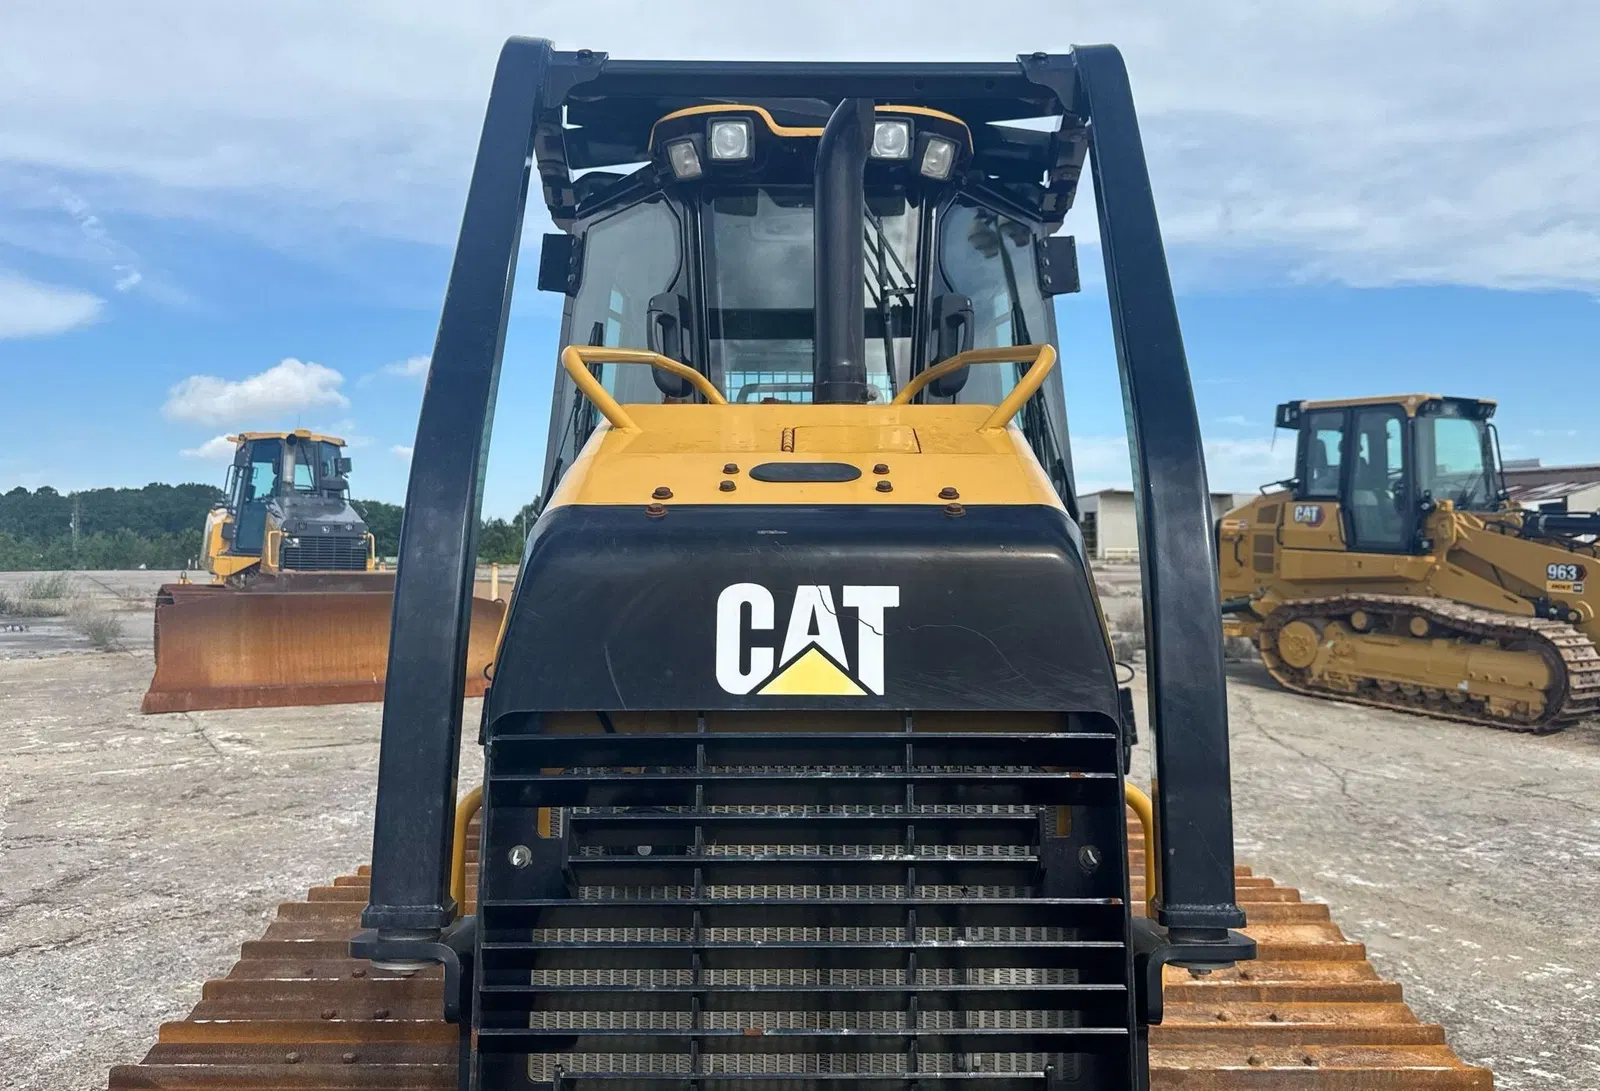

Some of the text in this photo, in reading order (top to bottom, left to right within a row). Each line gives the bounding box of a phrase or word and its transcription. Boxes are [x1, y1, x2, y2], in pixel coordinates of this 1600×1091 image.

[1294, 505, 1319, 522] CAT
[1547, 563, 1577, 580] 963
[716, 582, 900, 695] CAT
